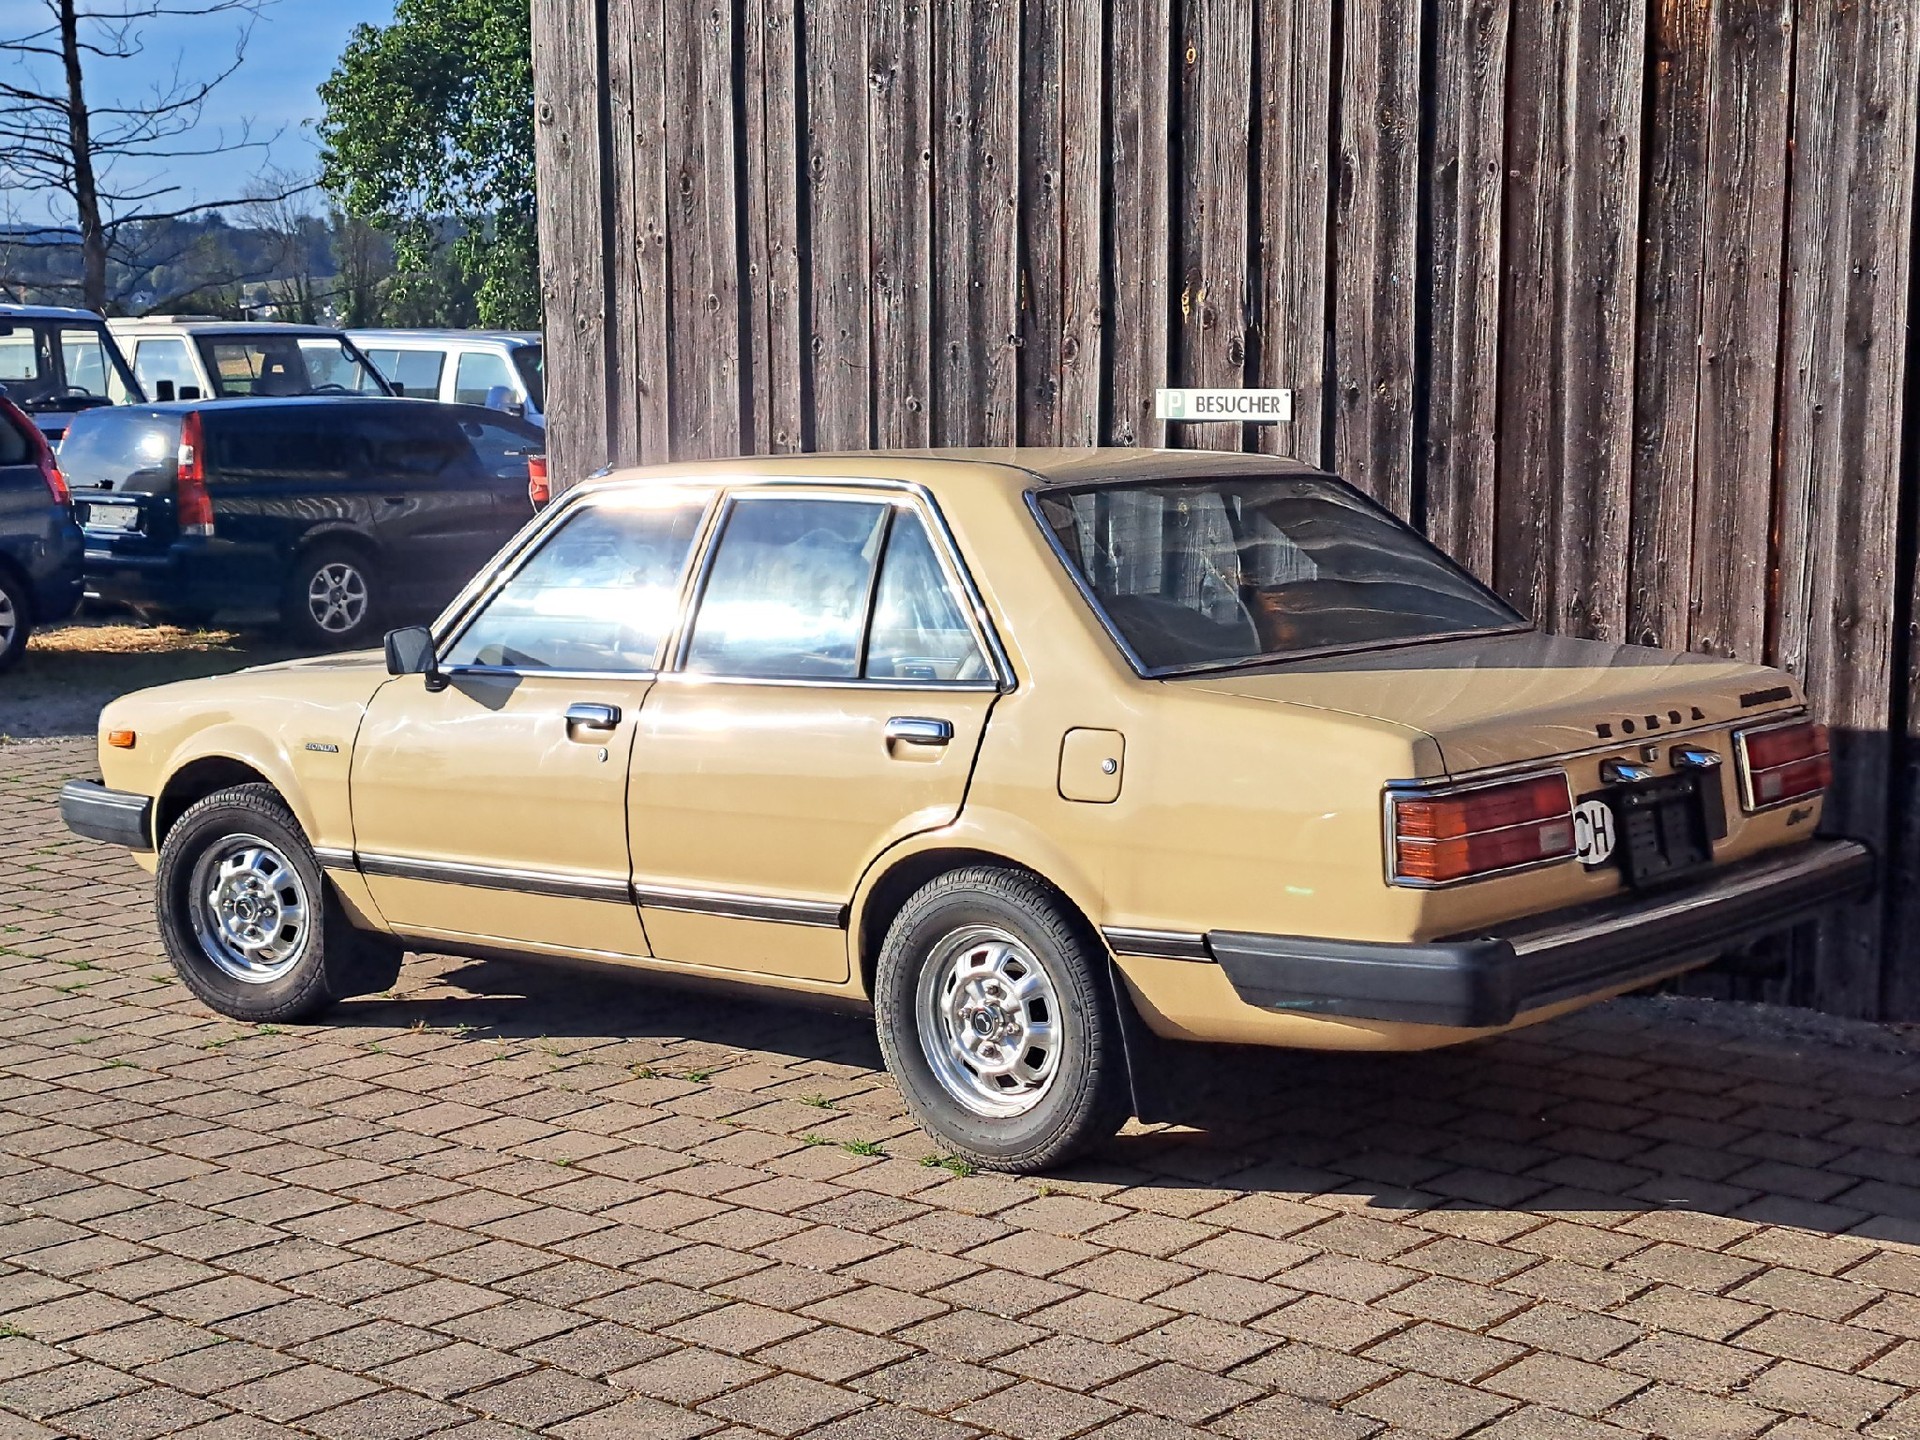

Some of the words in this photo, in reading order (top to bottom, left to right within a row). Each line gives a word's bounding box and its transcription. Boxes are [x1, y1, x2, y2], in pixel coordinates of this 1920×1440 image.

[1168, 391, 1182, 416] P
[1196, 396, 1281, 413] BESUCHER
[1575, 807, 1610, 857] CH
